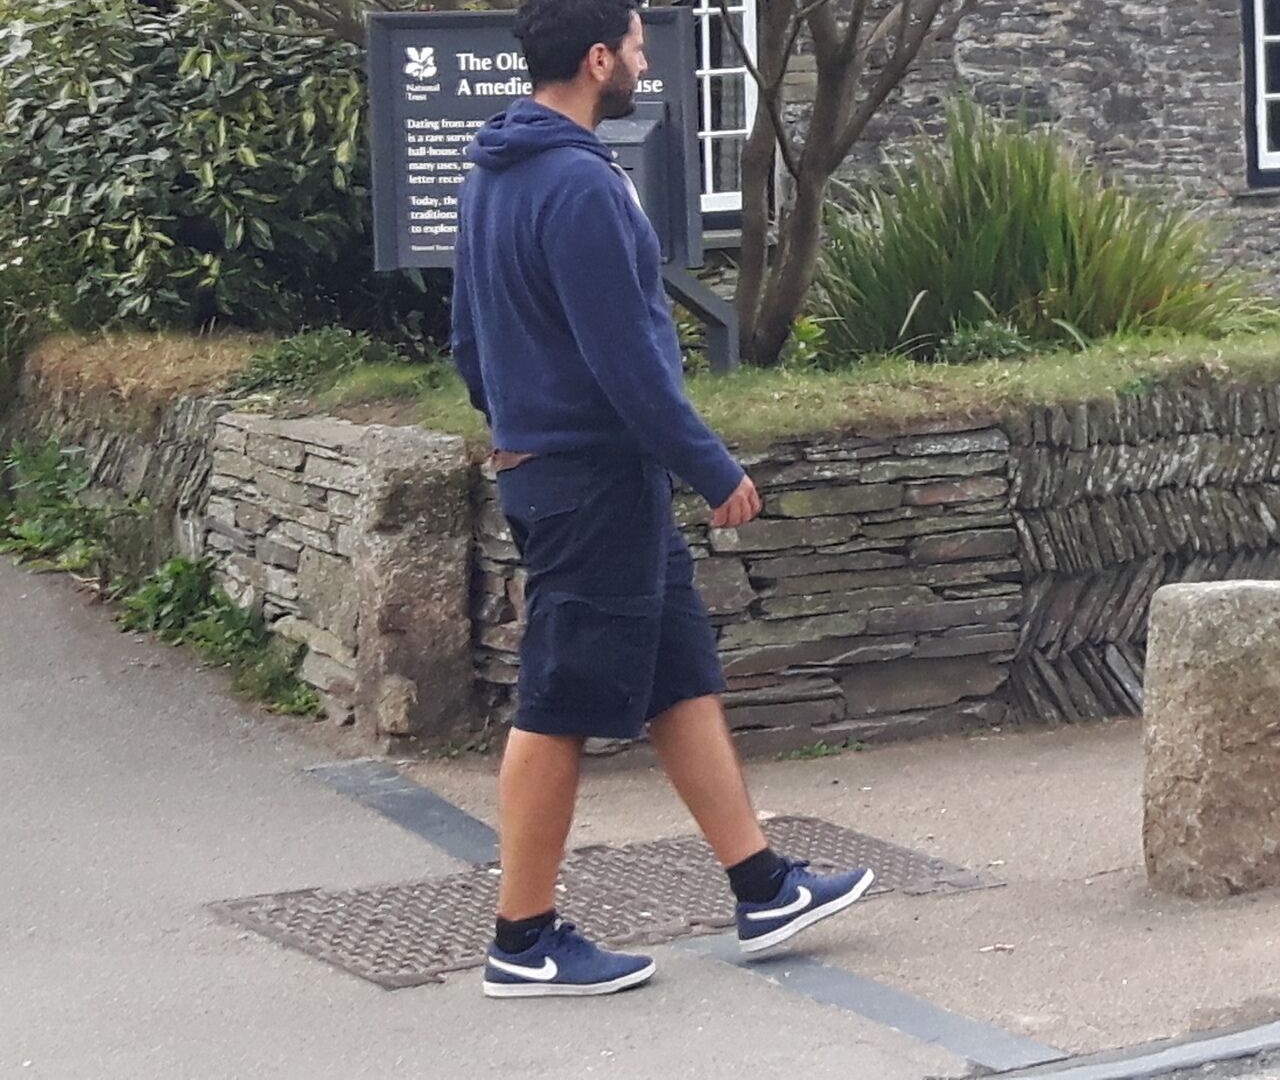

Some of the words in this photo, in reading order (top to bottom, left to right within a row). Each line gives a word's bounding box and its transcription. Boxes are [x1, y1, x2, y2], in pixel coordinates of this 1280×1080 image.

[456, 52, 492, 71] The
[457, 78, 472, 95] A
[475, 77, 533, 95] medie
[407, 119, 439, 131] Dating
[441, 119, 465, 128] from
[409, 195, 441, 207] Today,
[410, 209, 458, 219] traditiona
